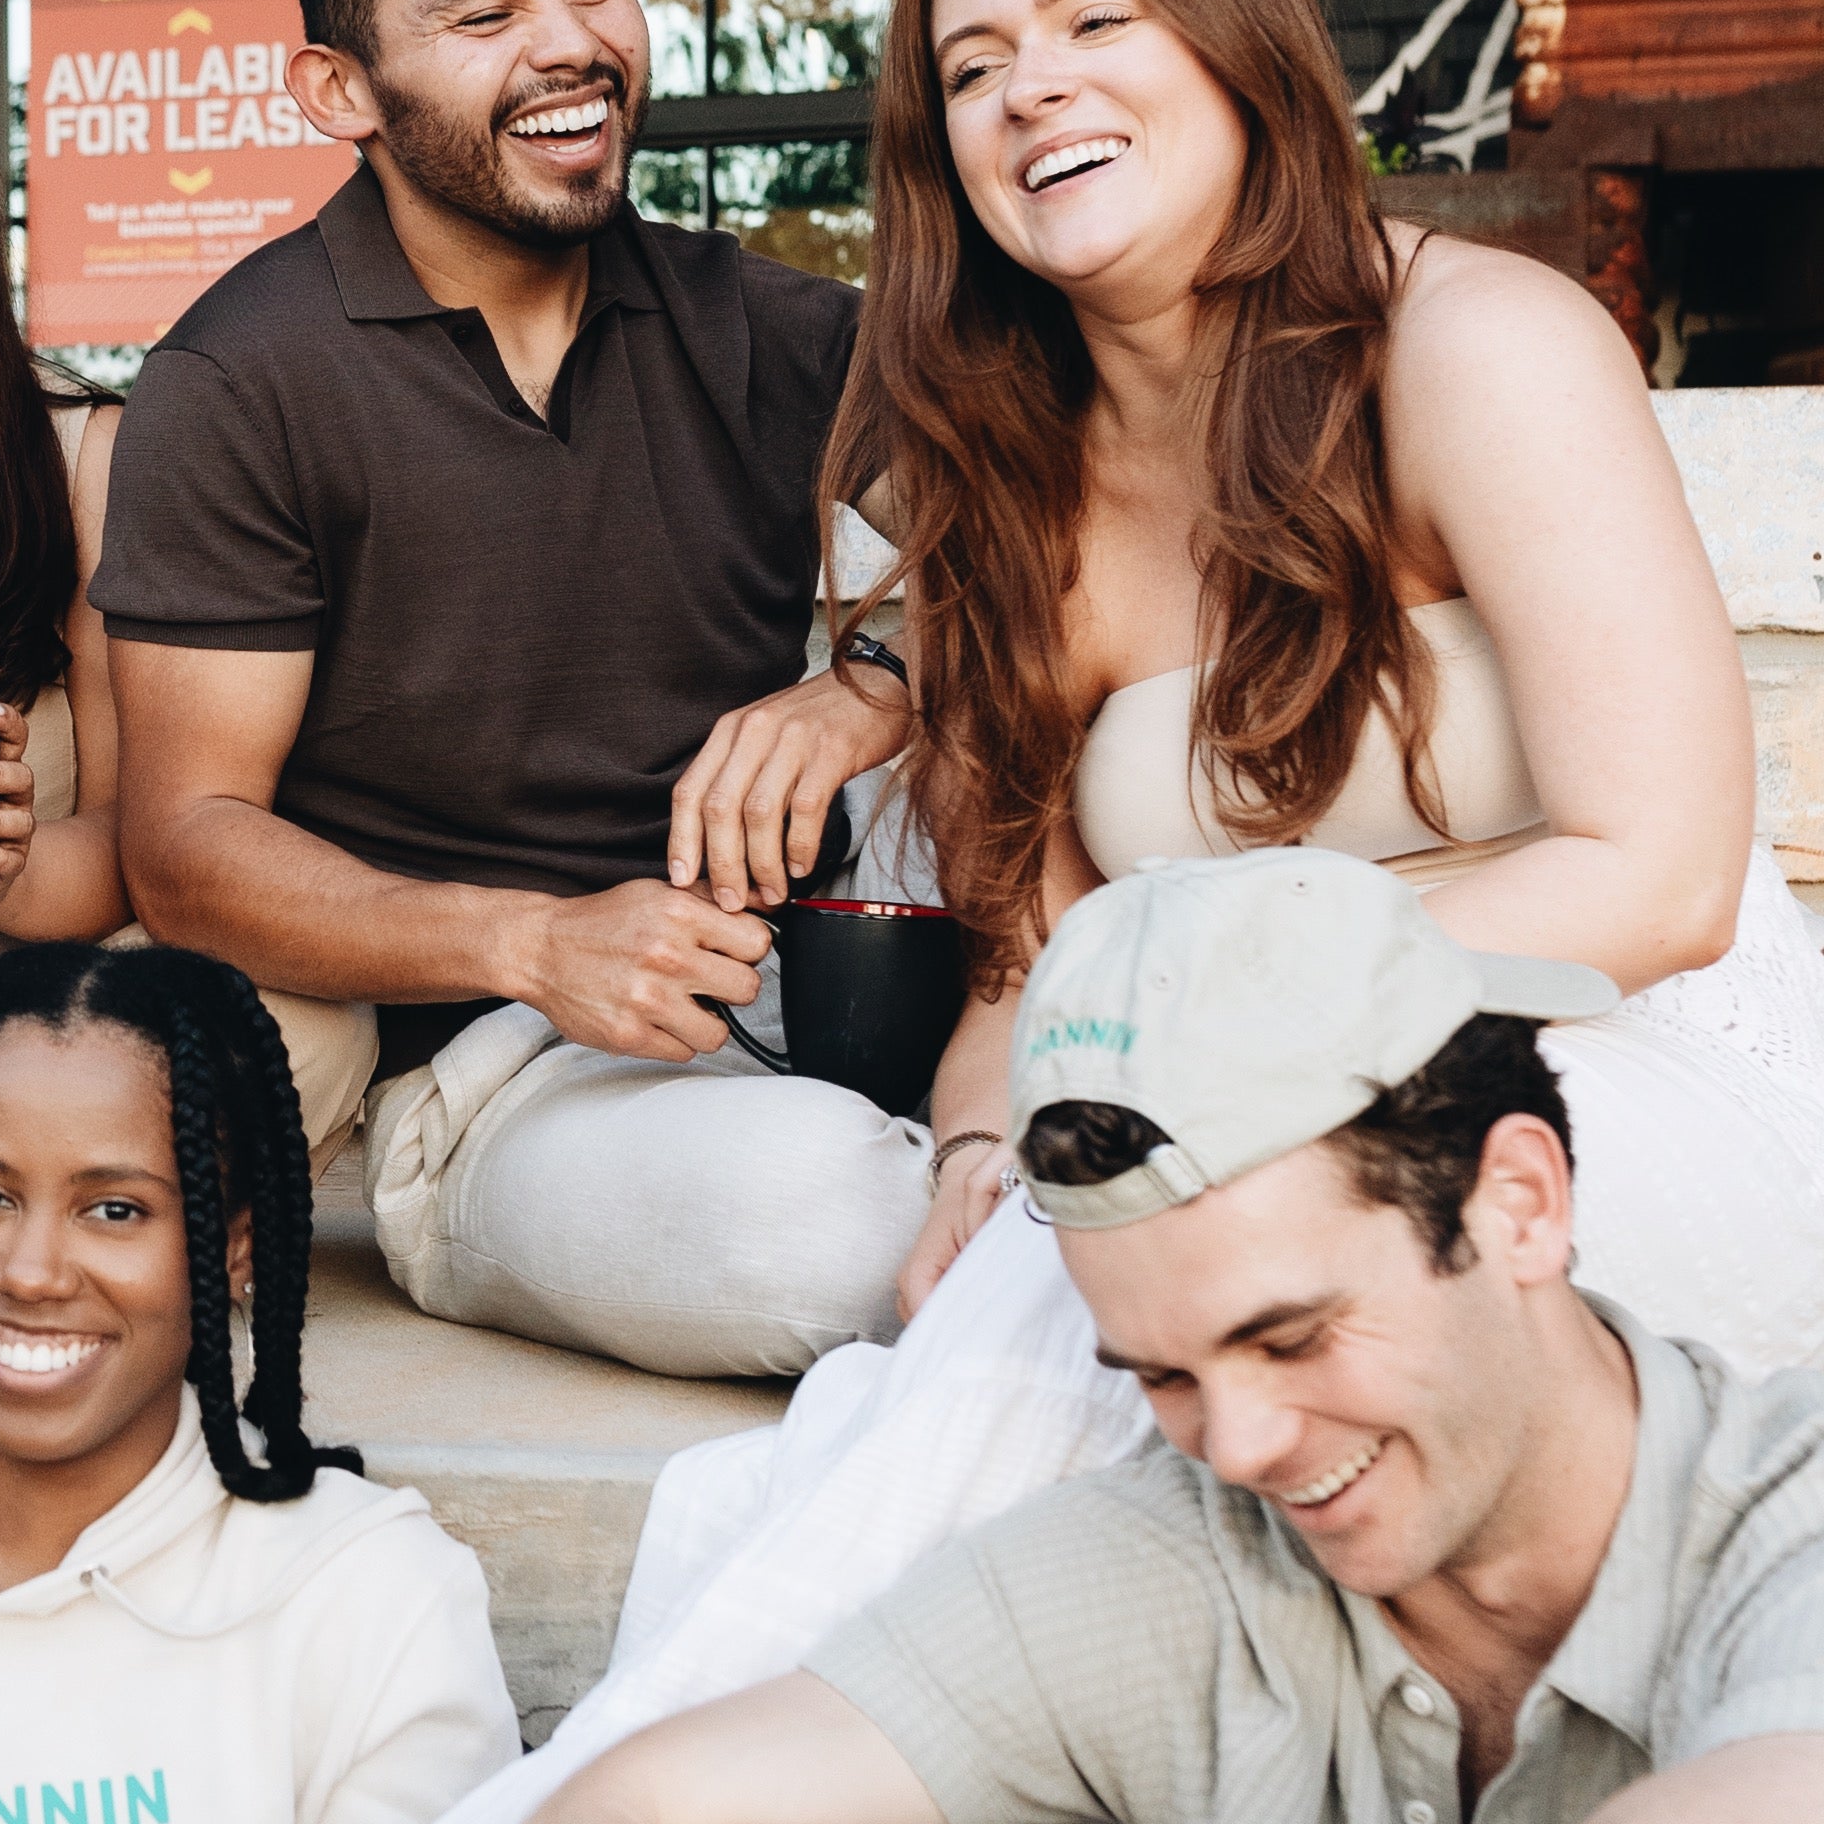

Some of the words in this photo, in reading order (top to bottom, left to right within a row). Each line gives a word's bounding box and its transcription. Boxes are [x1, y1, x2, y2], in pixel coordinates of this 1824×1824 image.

[43, 41, 287, 105] AVAILABL
[44, 102, 151, 158] FOR
[84, 202, 116, 222] Tell
[119, 206, 139, 219] us
[142, 200, 186, 218] what
[252, 198, 293, 219] your
[118, 220, 194, 238] business
